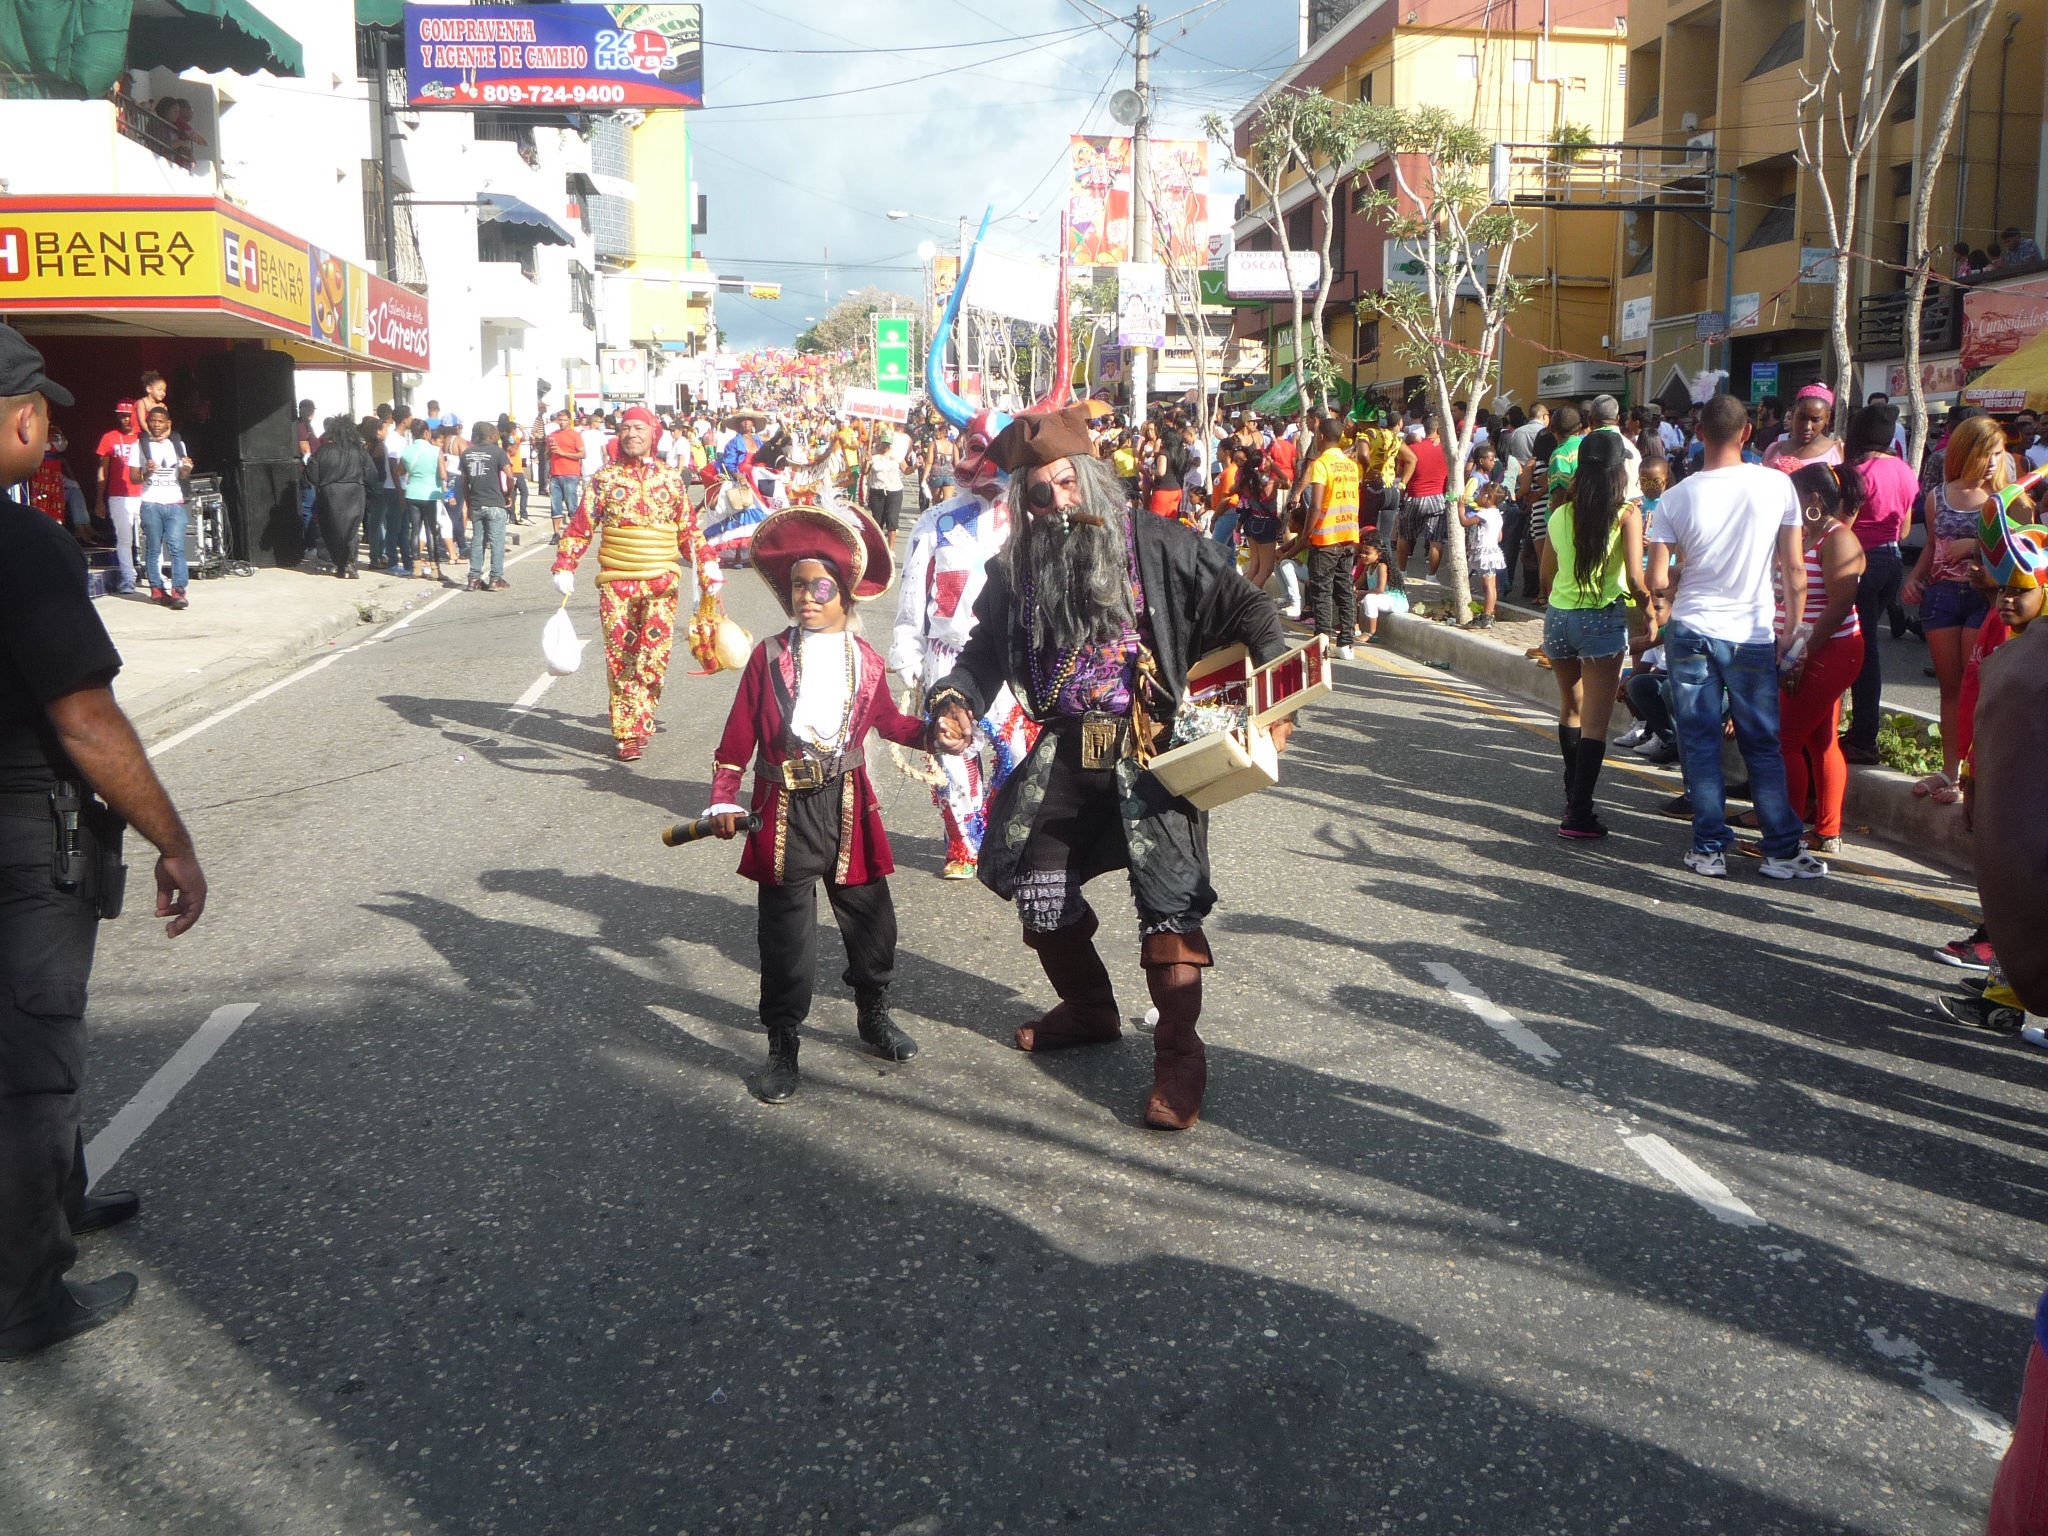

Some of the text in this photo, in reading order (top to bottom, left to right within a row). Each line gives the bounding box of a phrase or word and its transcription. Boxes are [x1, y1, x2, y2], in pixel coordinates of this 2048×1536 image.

[419, 18, 536, 43] COMPRAVENTA
[596, 30, 637, 52] 24
[421, 45, 588, 68] Y AGENTE DE CAMBIO
[595, 50, 677, 71] Horas
[483, 84, 625, 104] 809-724-9400
[35, 231, 195, 254] BANCA
[37, 254, 195, 277] HENRY
[260, 249, 303, 285] BANCA
[261, 271, 304, 307] HENRY
[352, 288, 428, 358] Las Carreras
